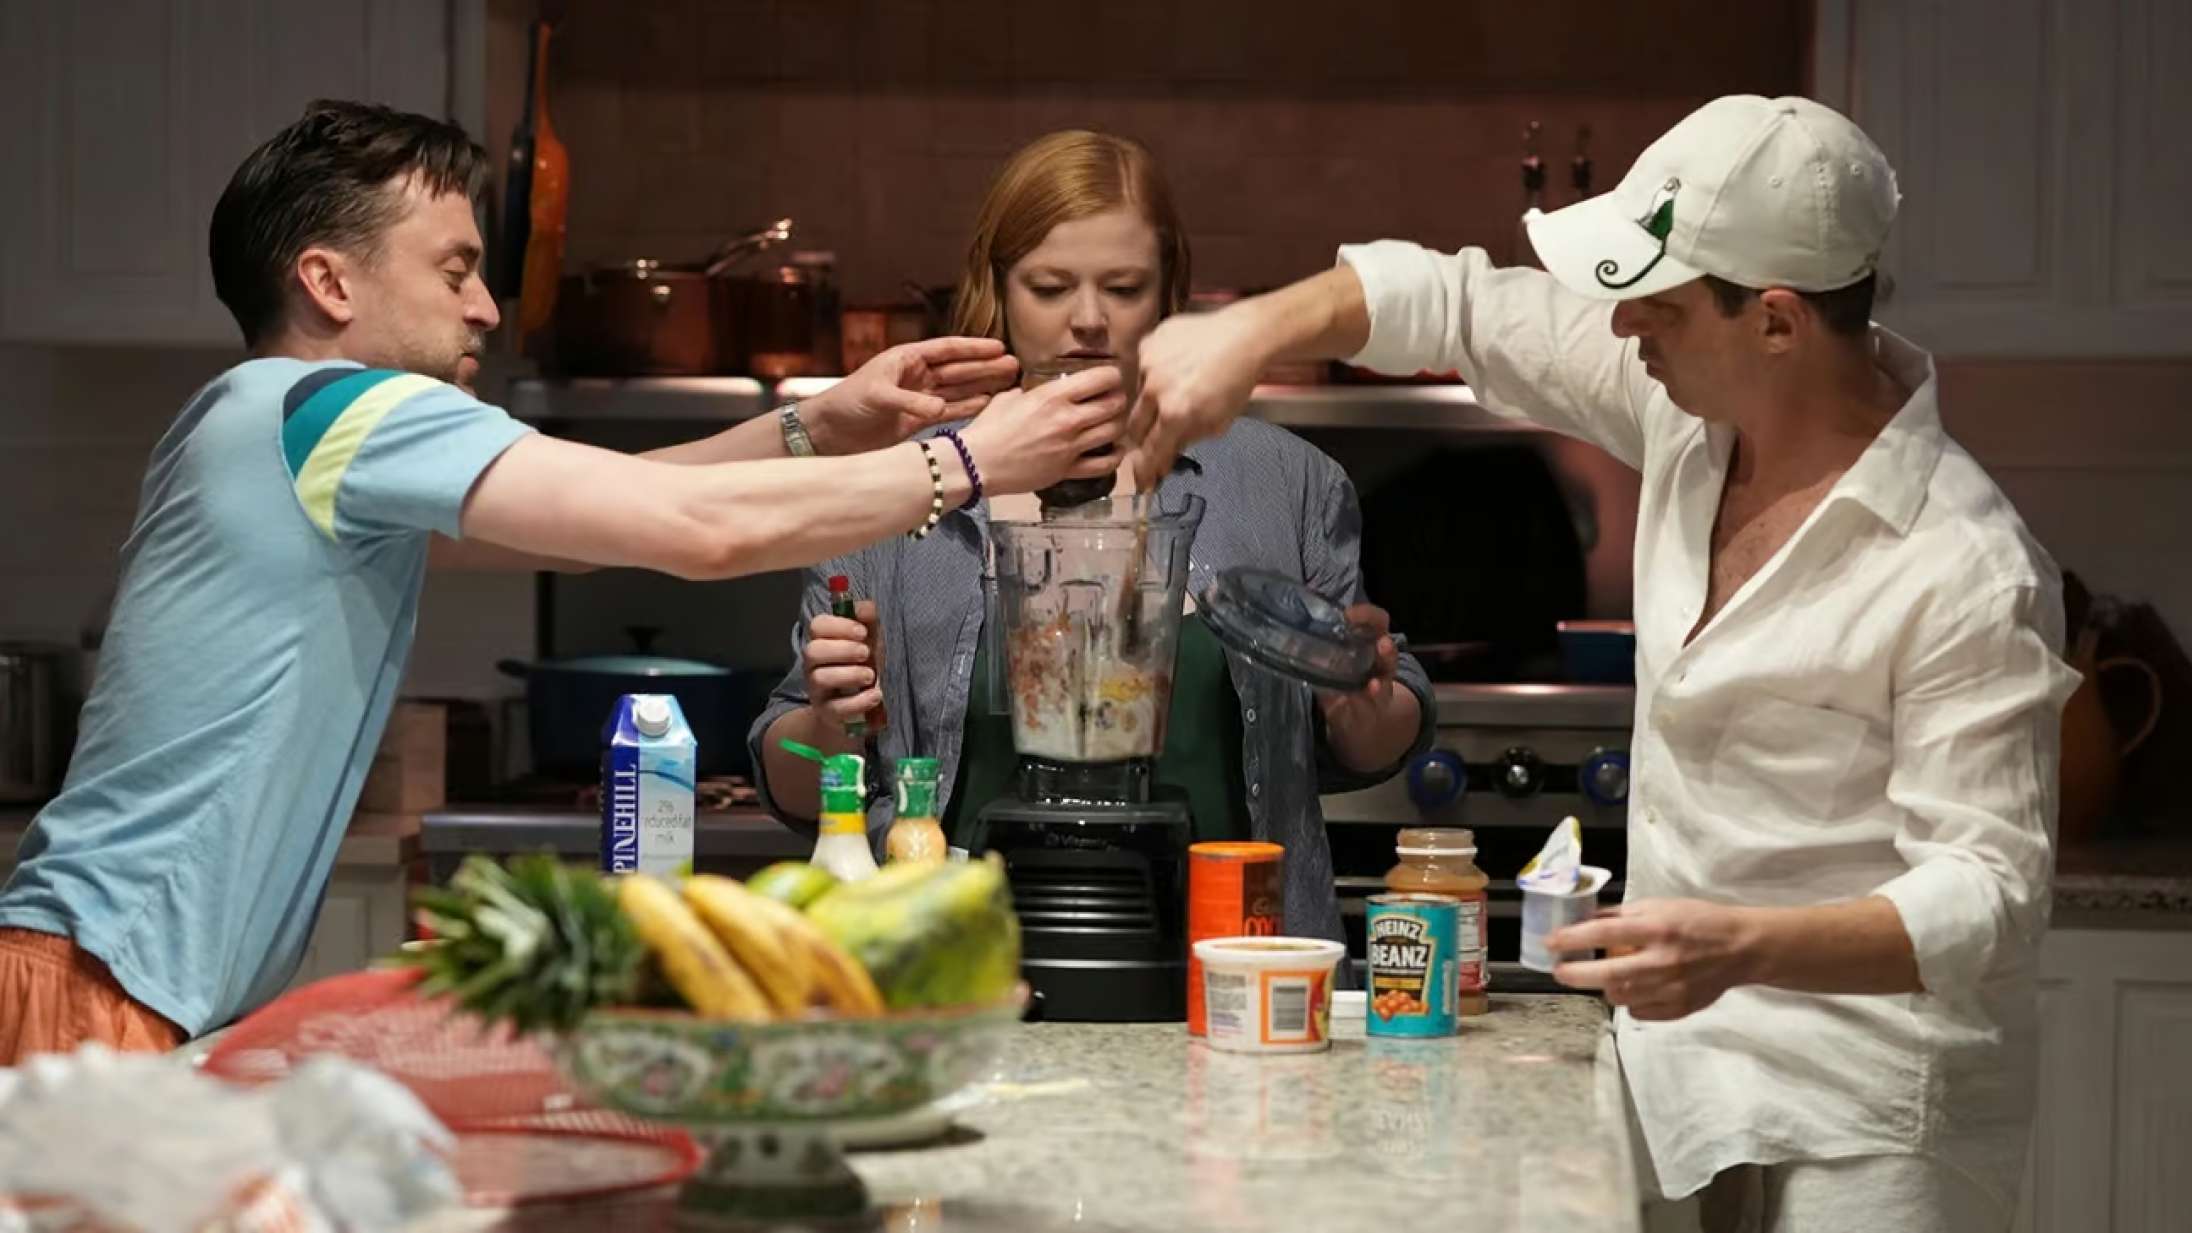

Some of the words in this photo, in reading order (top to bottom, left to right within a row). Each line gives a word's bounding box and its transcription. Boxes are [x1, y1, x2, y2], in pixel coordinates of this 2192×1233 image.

[613, 764, 637, 873] PINEHILL
[1376, 919, 1421, 940] HEINZ
[1371, 944, 1428, 968] BEANZ
